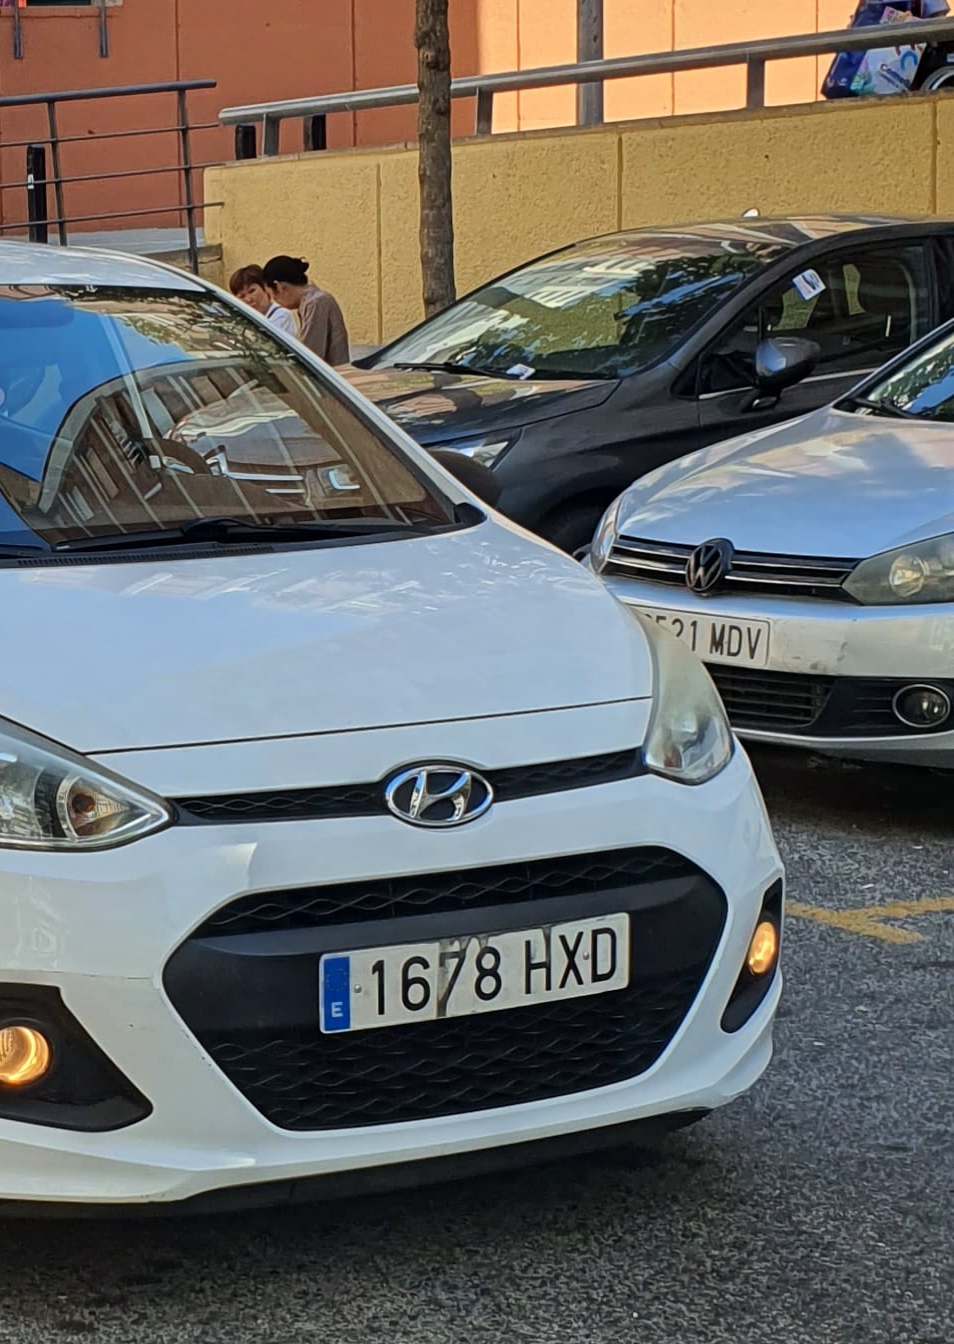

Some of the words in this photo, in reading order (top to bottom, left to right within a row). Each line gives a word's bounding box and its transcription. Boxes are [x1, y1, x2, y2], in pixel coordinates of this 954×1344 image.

[644, 613, 697, 652] 21
[709, 622, 762, 660] MDV
[371, 944, 502, 1016] 1678
[524, 926, 617, 995] HXD
